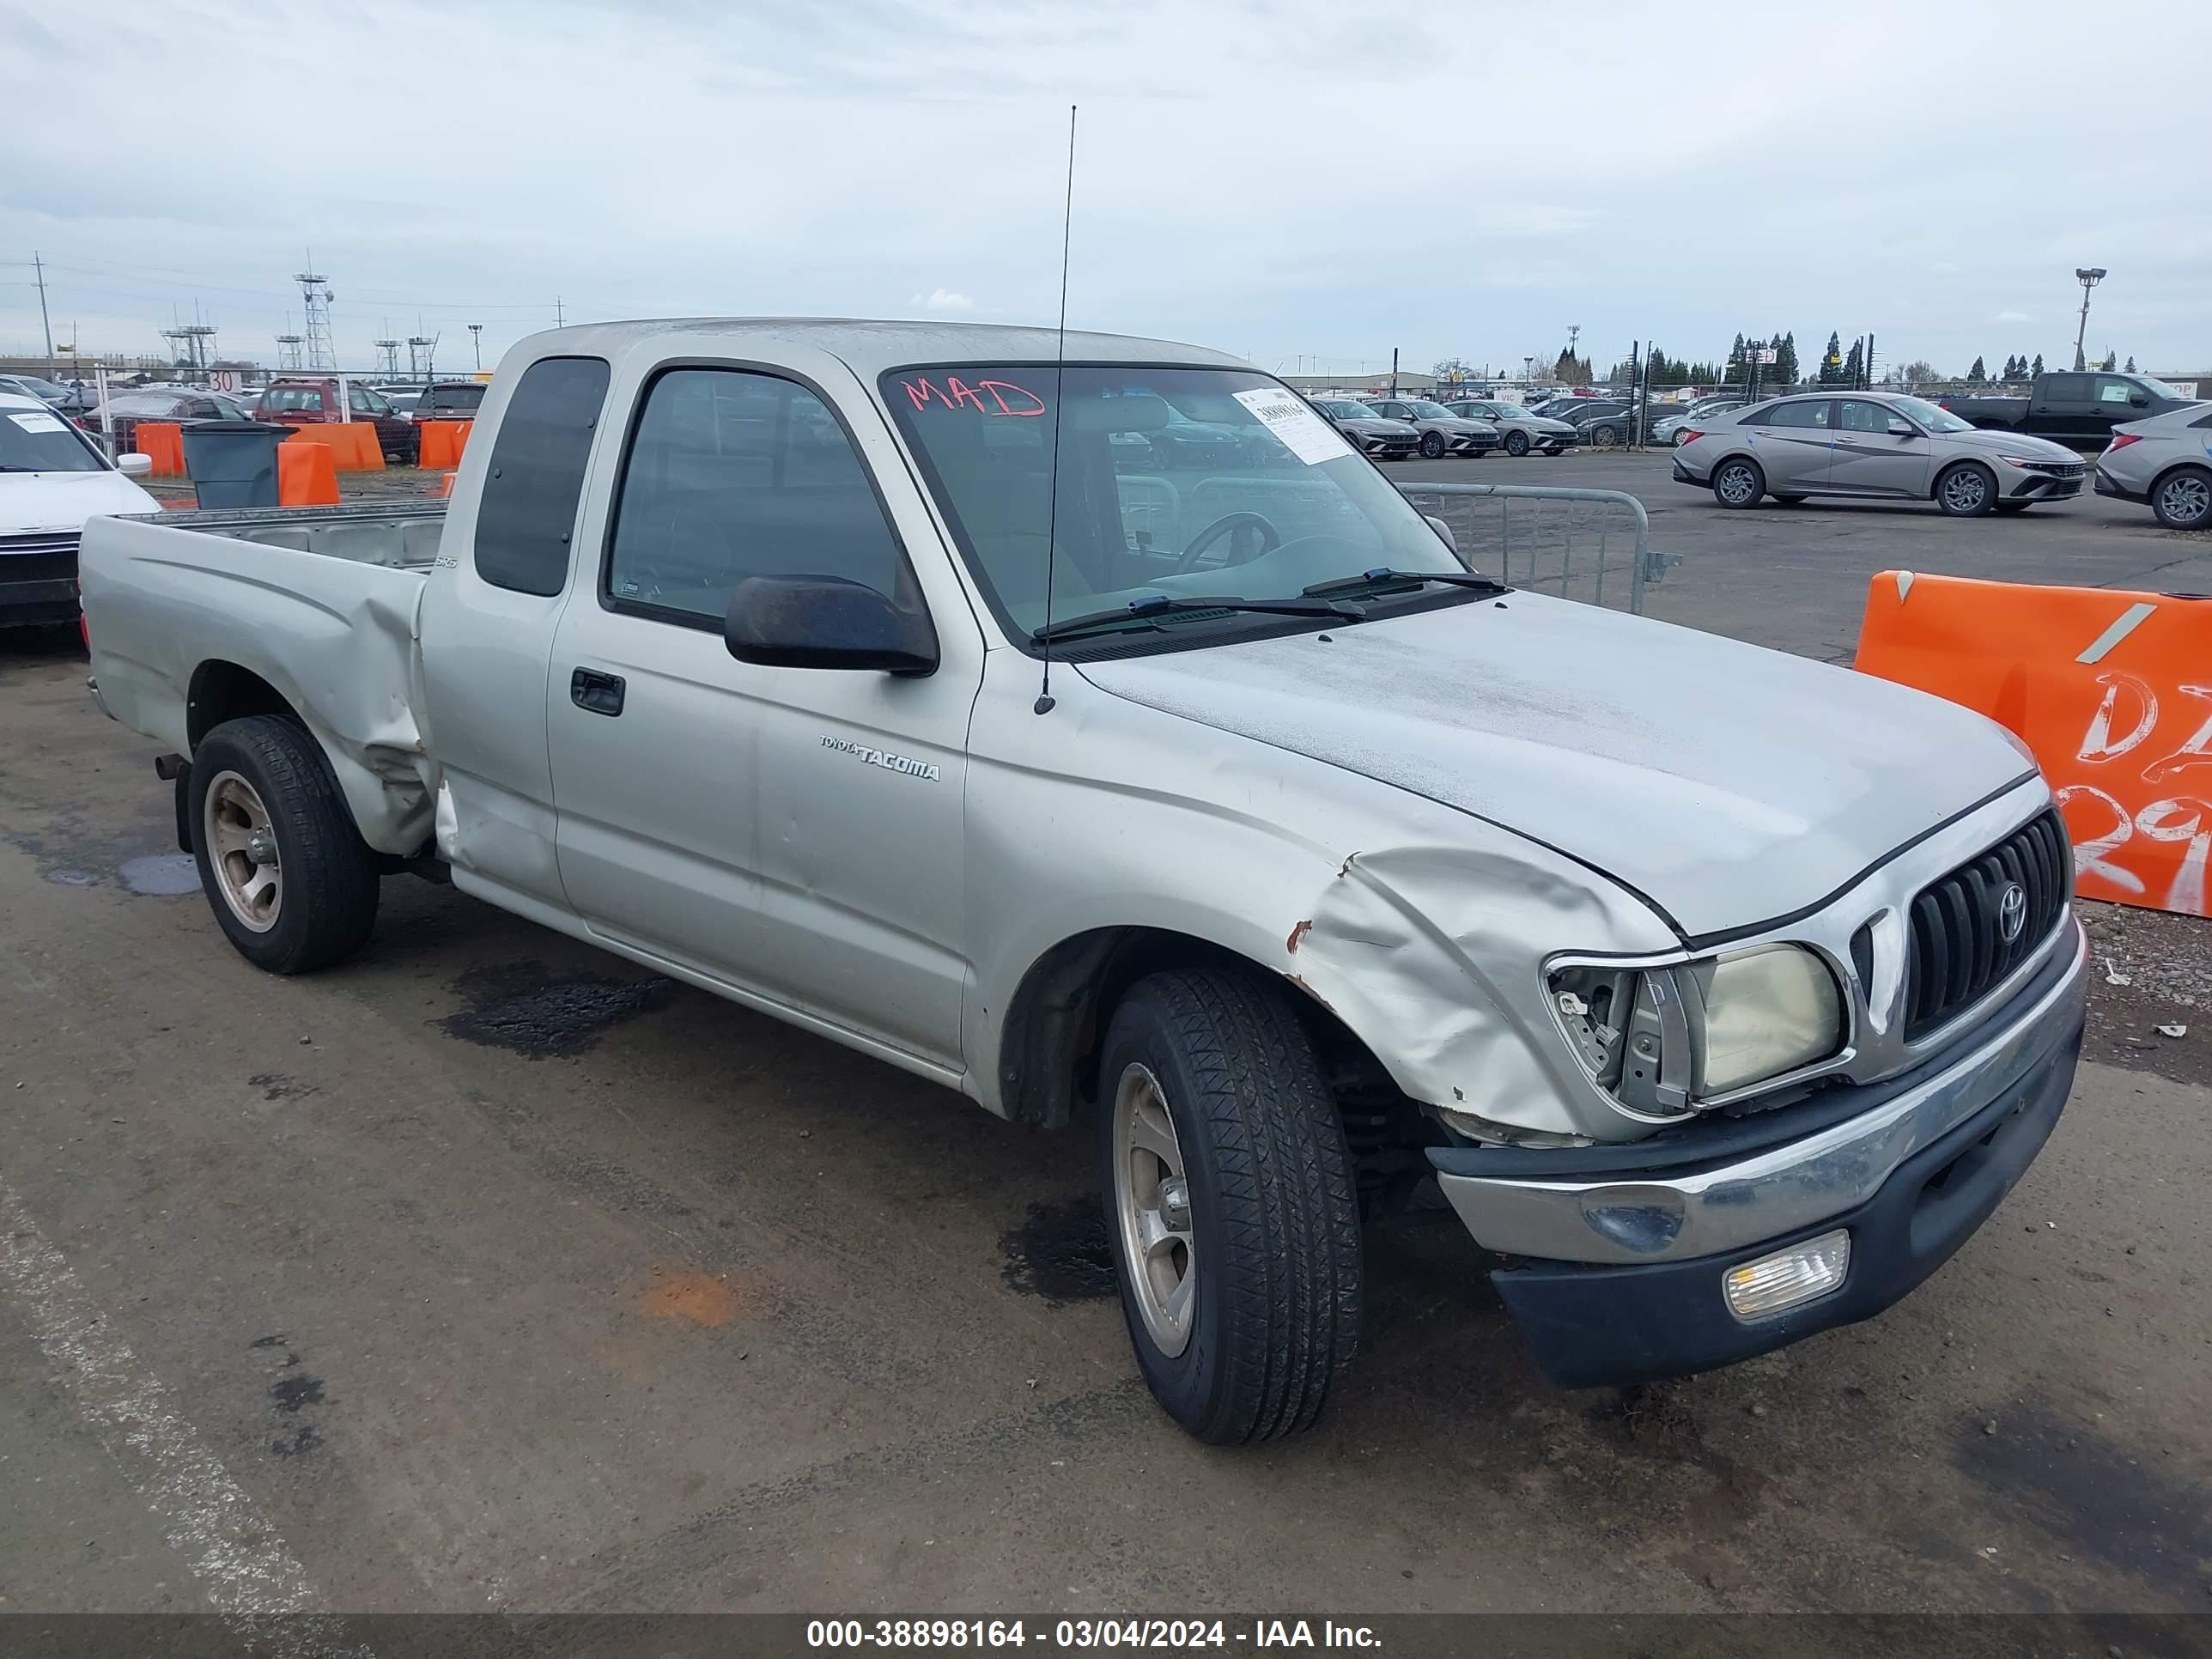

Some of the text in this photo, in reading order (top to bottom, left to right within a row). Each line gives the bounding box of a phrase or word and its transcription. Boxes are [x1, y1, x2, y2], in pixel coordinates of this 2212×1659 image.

[211, 371, 234, 392] 30
[900, 378, 1045, 416] MAD
[820, 735, 940, 781] TOYOTA TACOMA
